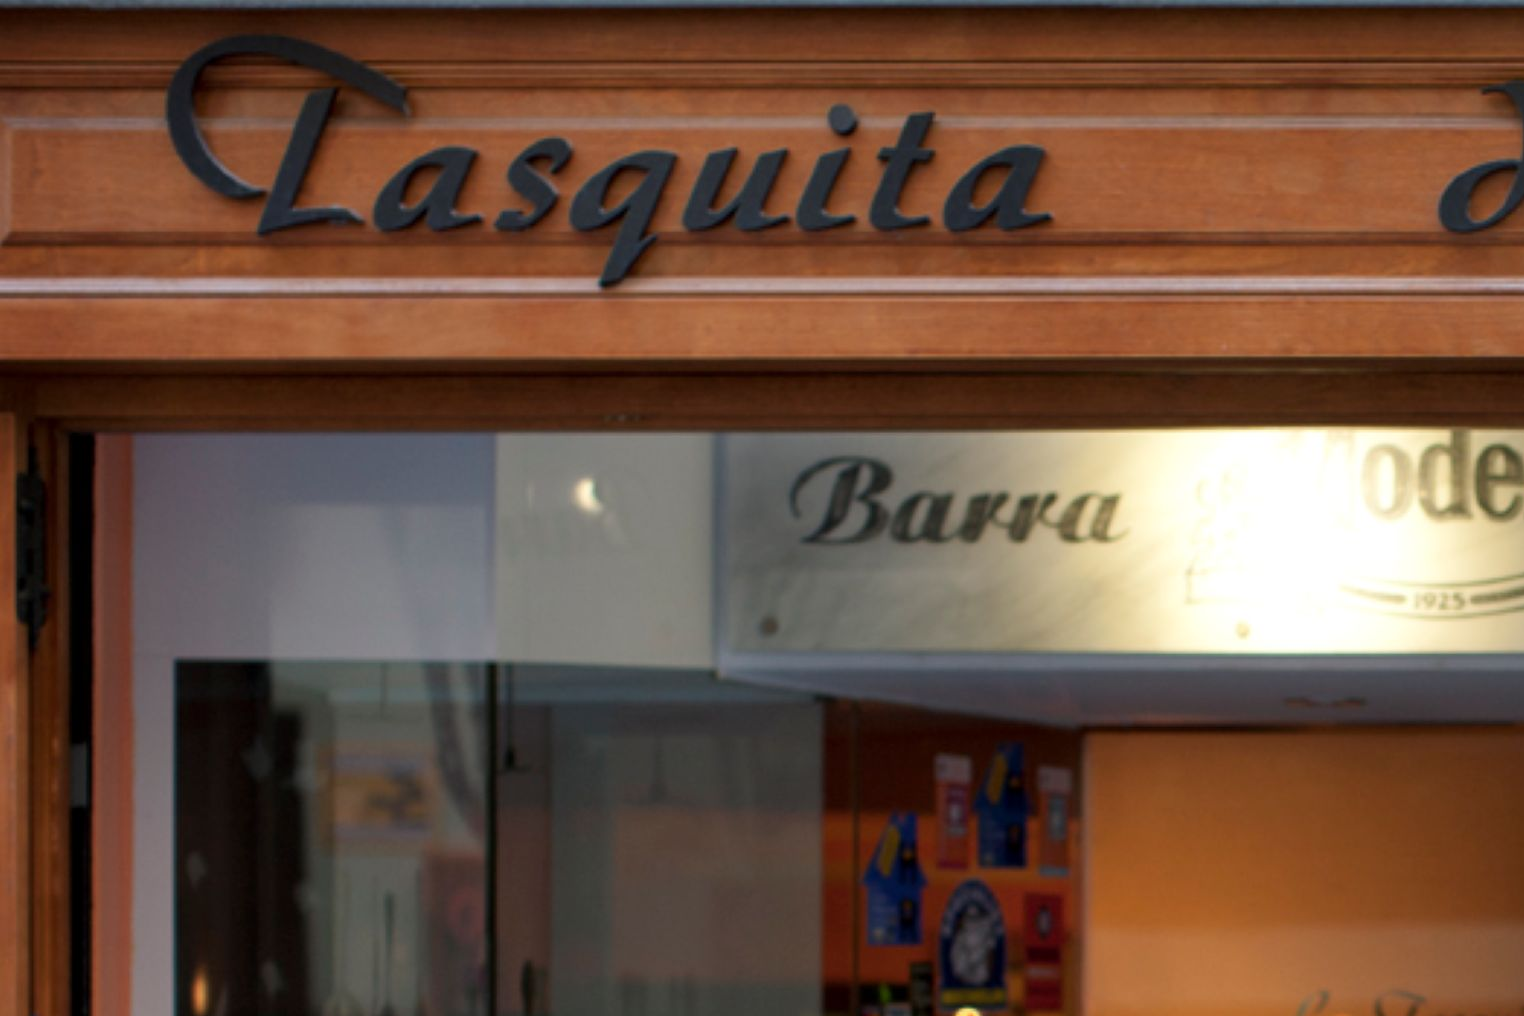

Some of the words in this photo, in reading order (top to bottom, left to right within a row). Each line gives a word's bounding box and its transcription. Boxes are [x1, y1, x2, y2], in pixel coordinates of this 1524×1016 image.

[166, 33, 1054, 289] Tasquita
[789, 455, 1130, 544] Barra
[1413, 591, 1467, 611] 1925
